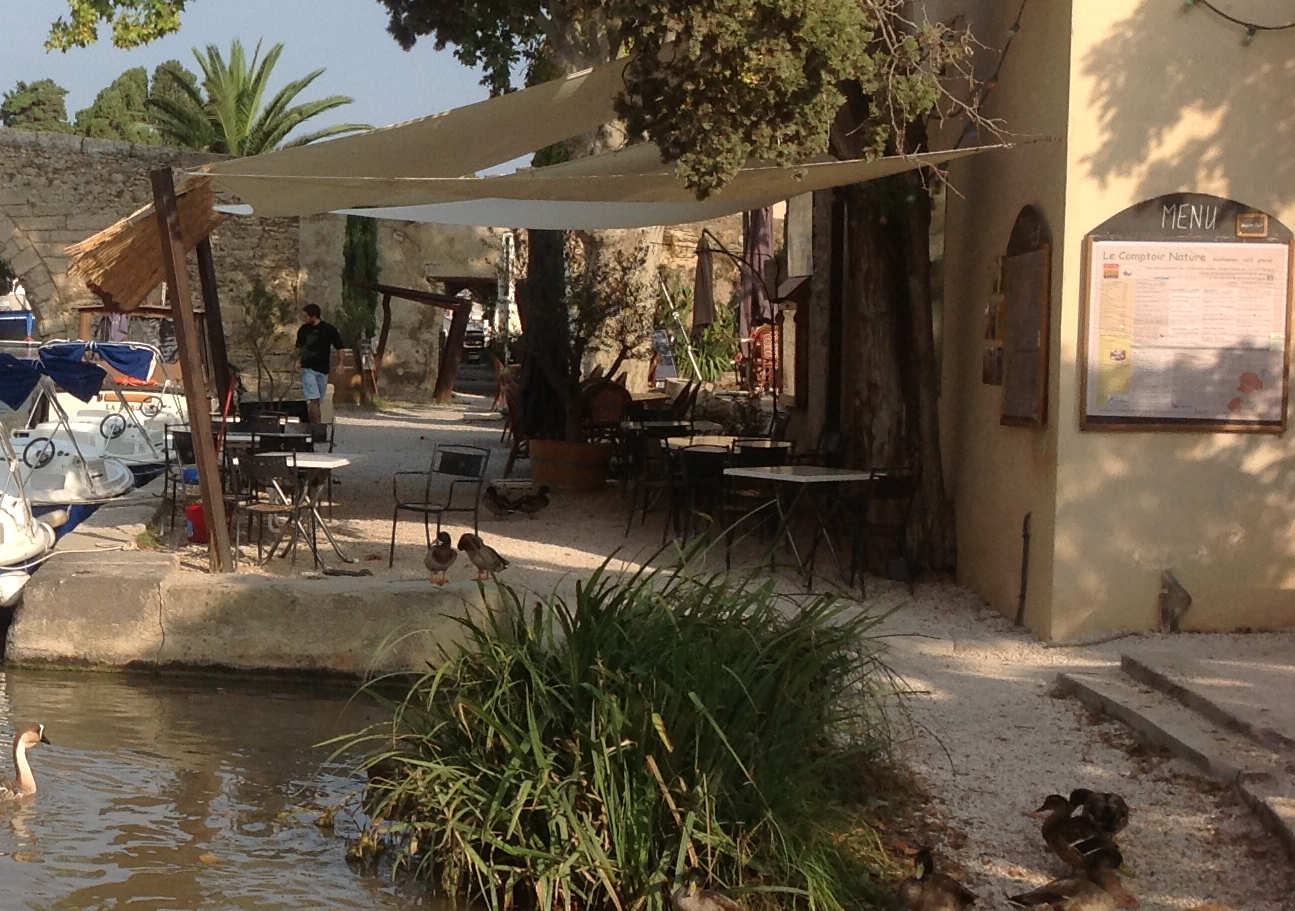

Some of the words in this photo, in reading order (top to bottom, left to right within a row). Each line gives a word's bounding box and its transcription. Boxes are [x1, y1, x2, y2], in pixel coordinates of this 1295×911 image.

[1161, 203, 1217, 230] MENU
[1103, 251, 1115, 261] Le
[1118, 251, 1165, 263] Comptoir
[1168, 252, 1206, 262] Nature
